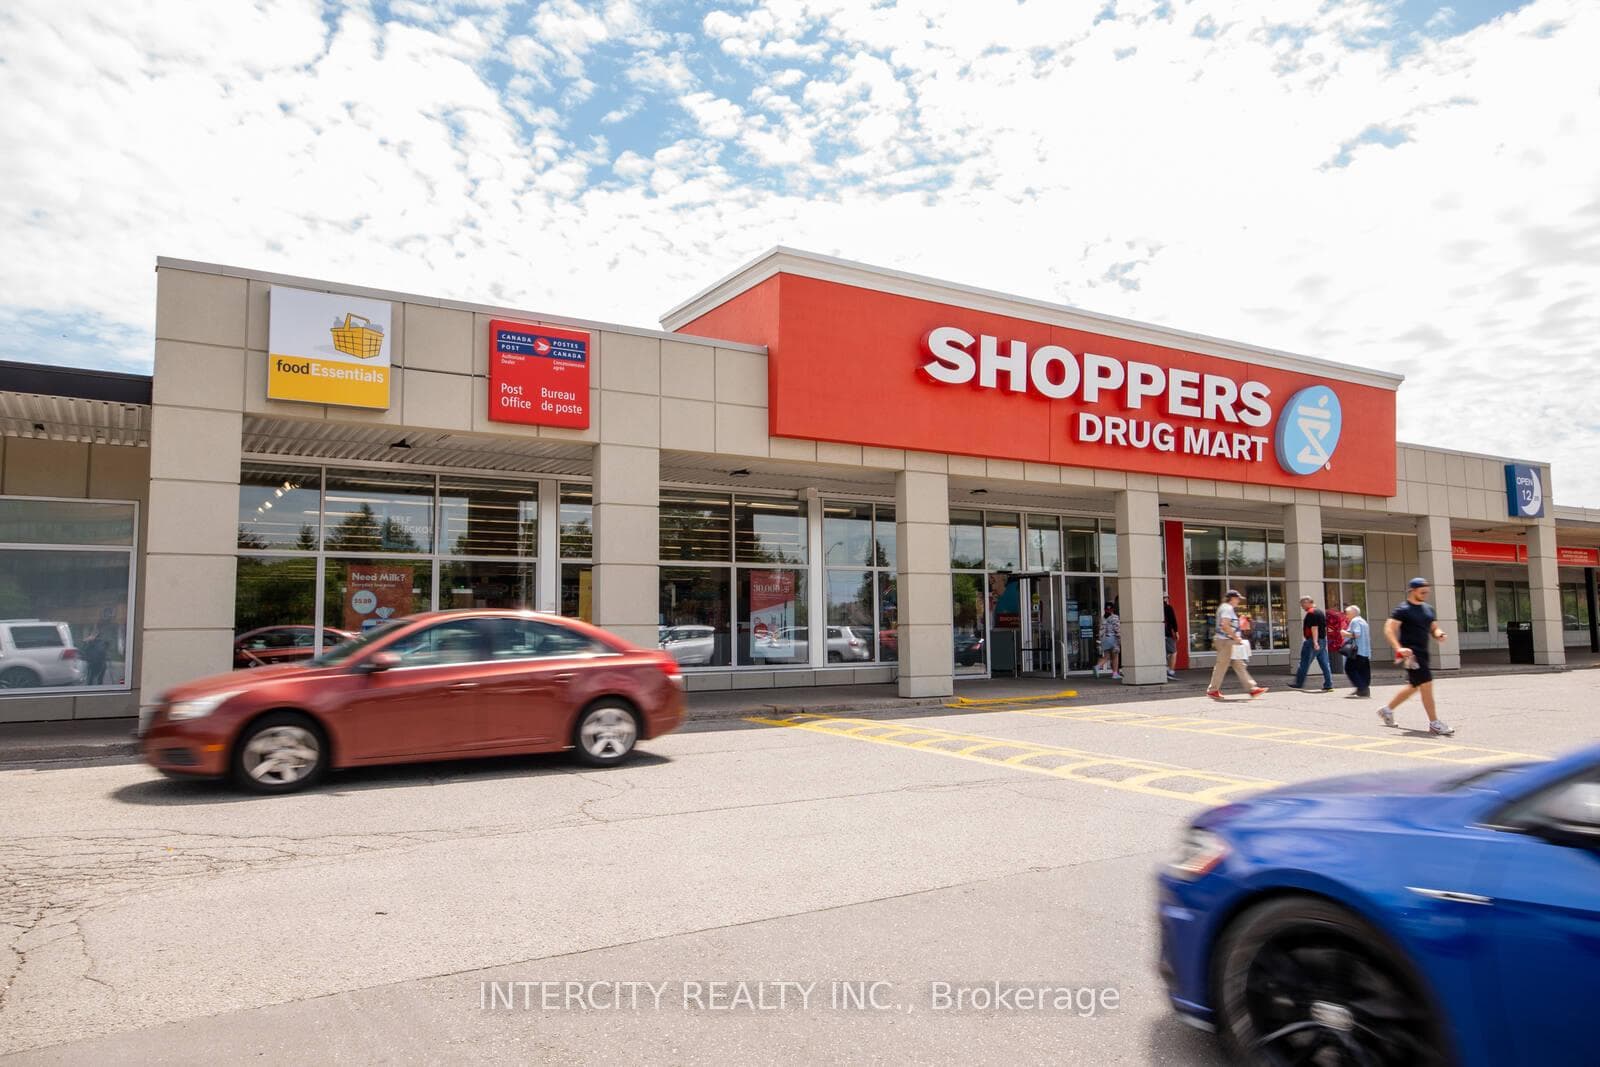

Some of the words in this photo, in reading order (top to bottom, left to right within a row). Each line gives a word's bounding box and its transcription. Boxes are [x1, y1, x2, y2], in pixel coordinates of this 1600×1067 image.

[501, 333, 532, 343] CANADA
[501, 343, 519, 351] POST
[553, 341, 578, 349] POSTES
[553, 351, 581, 359] CANADA
[923, 327, 1271, 427] SHOPPERS
[501, 383, 523, 395] Post
[541, 387, 575, 401] Bureau
[501, 396, 531, 409] Office
[541, 400, 553, 411] de
[555, 403, 583, 415] poste
[1079, 412, 1175, 452] DRUG
[1184, 427, 1269, 462] MART
[1516, 476, 1533, 486] OPEN
[1522, 489, 1532, 501] 12
[352, 572, 377, 581] Need
[380, 573, 406, 582] Milk?
